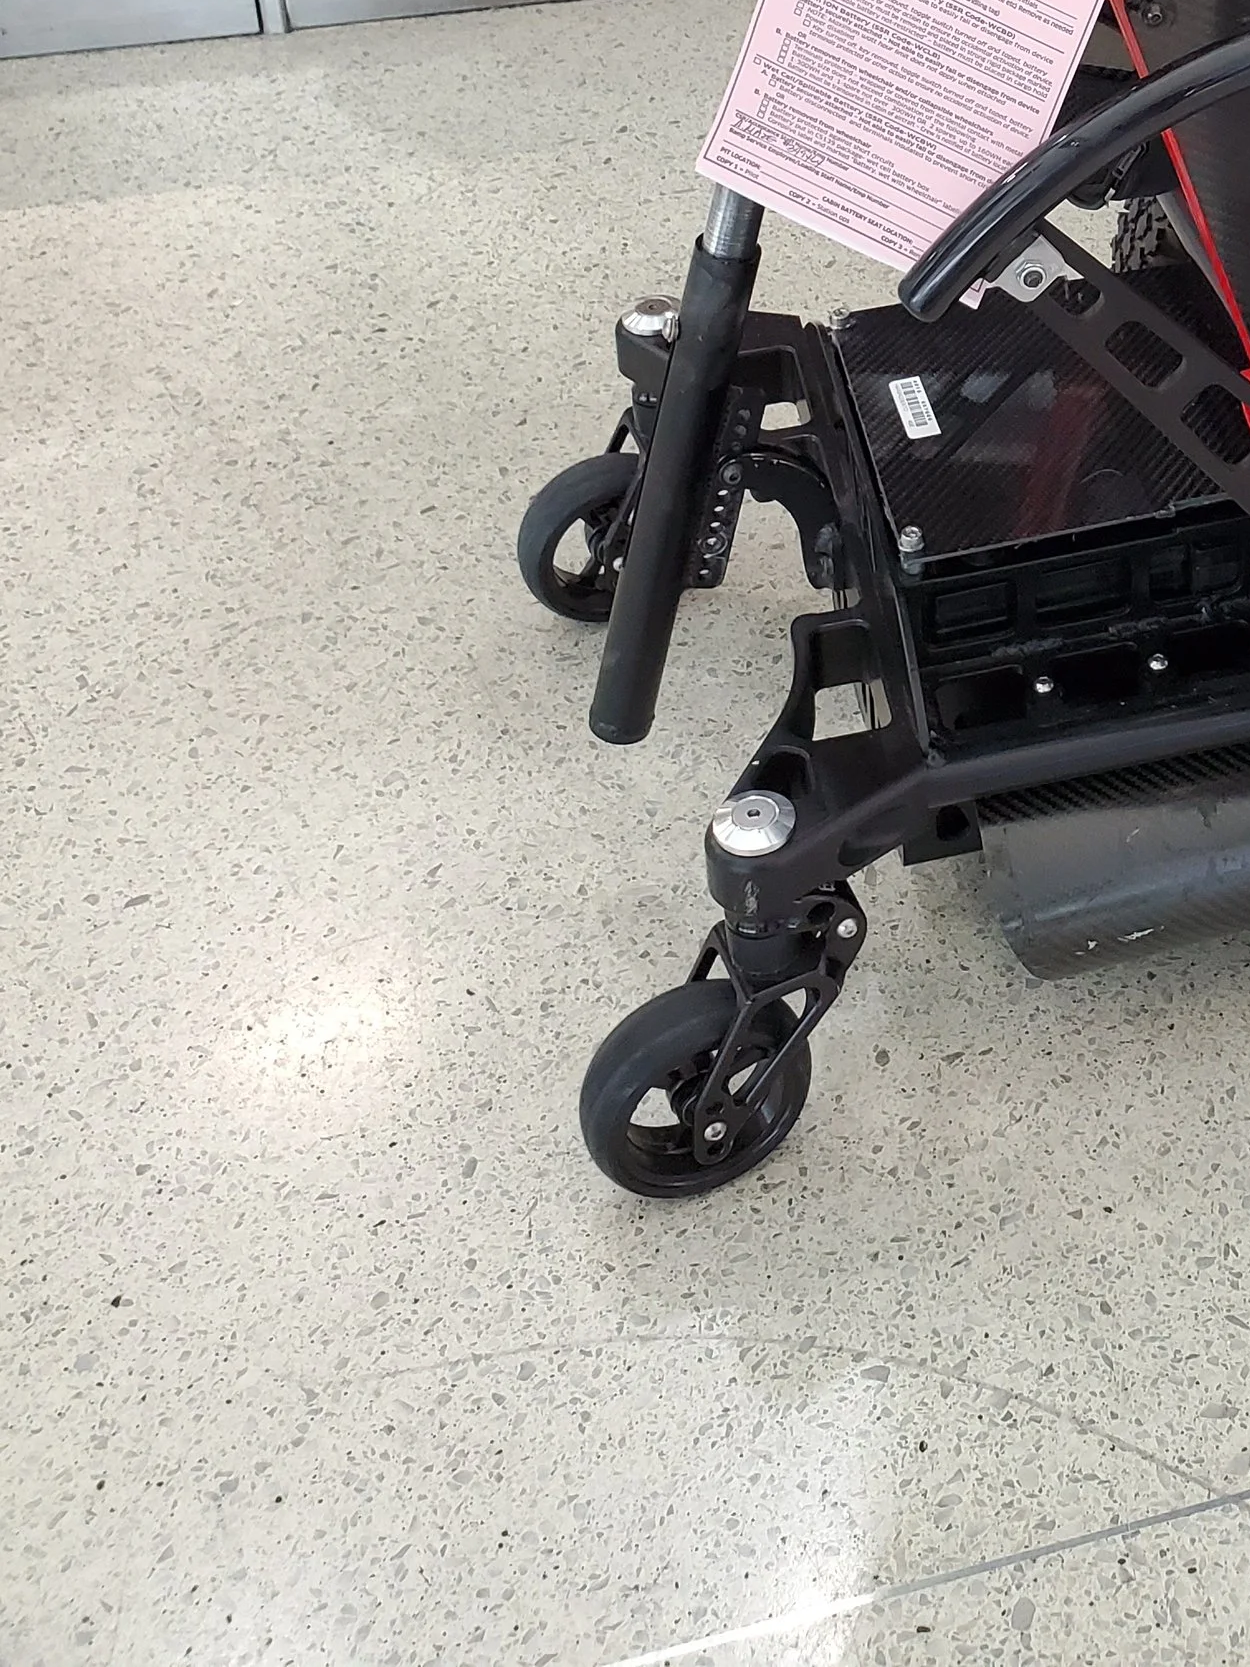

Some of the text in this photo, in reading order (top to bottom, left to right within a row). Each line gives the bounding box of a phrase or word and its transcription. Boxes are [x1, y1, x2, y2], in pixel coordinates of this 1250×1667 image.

[822, 0, 839, 11] ION
[839, 7, 871, 26] Battery
[871, 23, 890, 36] (SSR
[891, 32, 941, 60] Code-WCLB)
[945, 1, 964, 14] (SSR
[964, 10, 1016, 40] Code-WCBD)
[763, 61, 937, 151] Wet Cell/Spillable Battery (SSR Code-WCBW)
[719, 146, 761, 170] PIT LOCATION:
[821, 195, 914, 245] CABIN BATTERY SEAT LOCATION:
